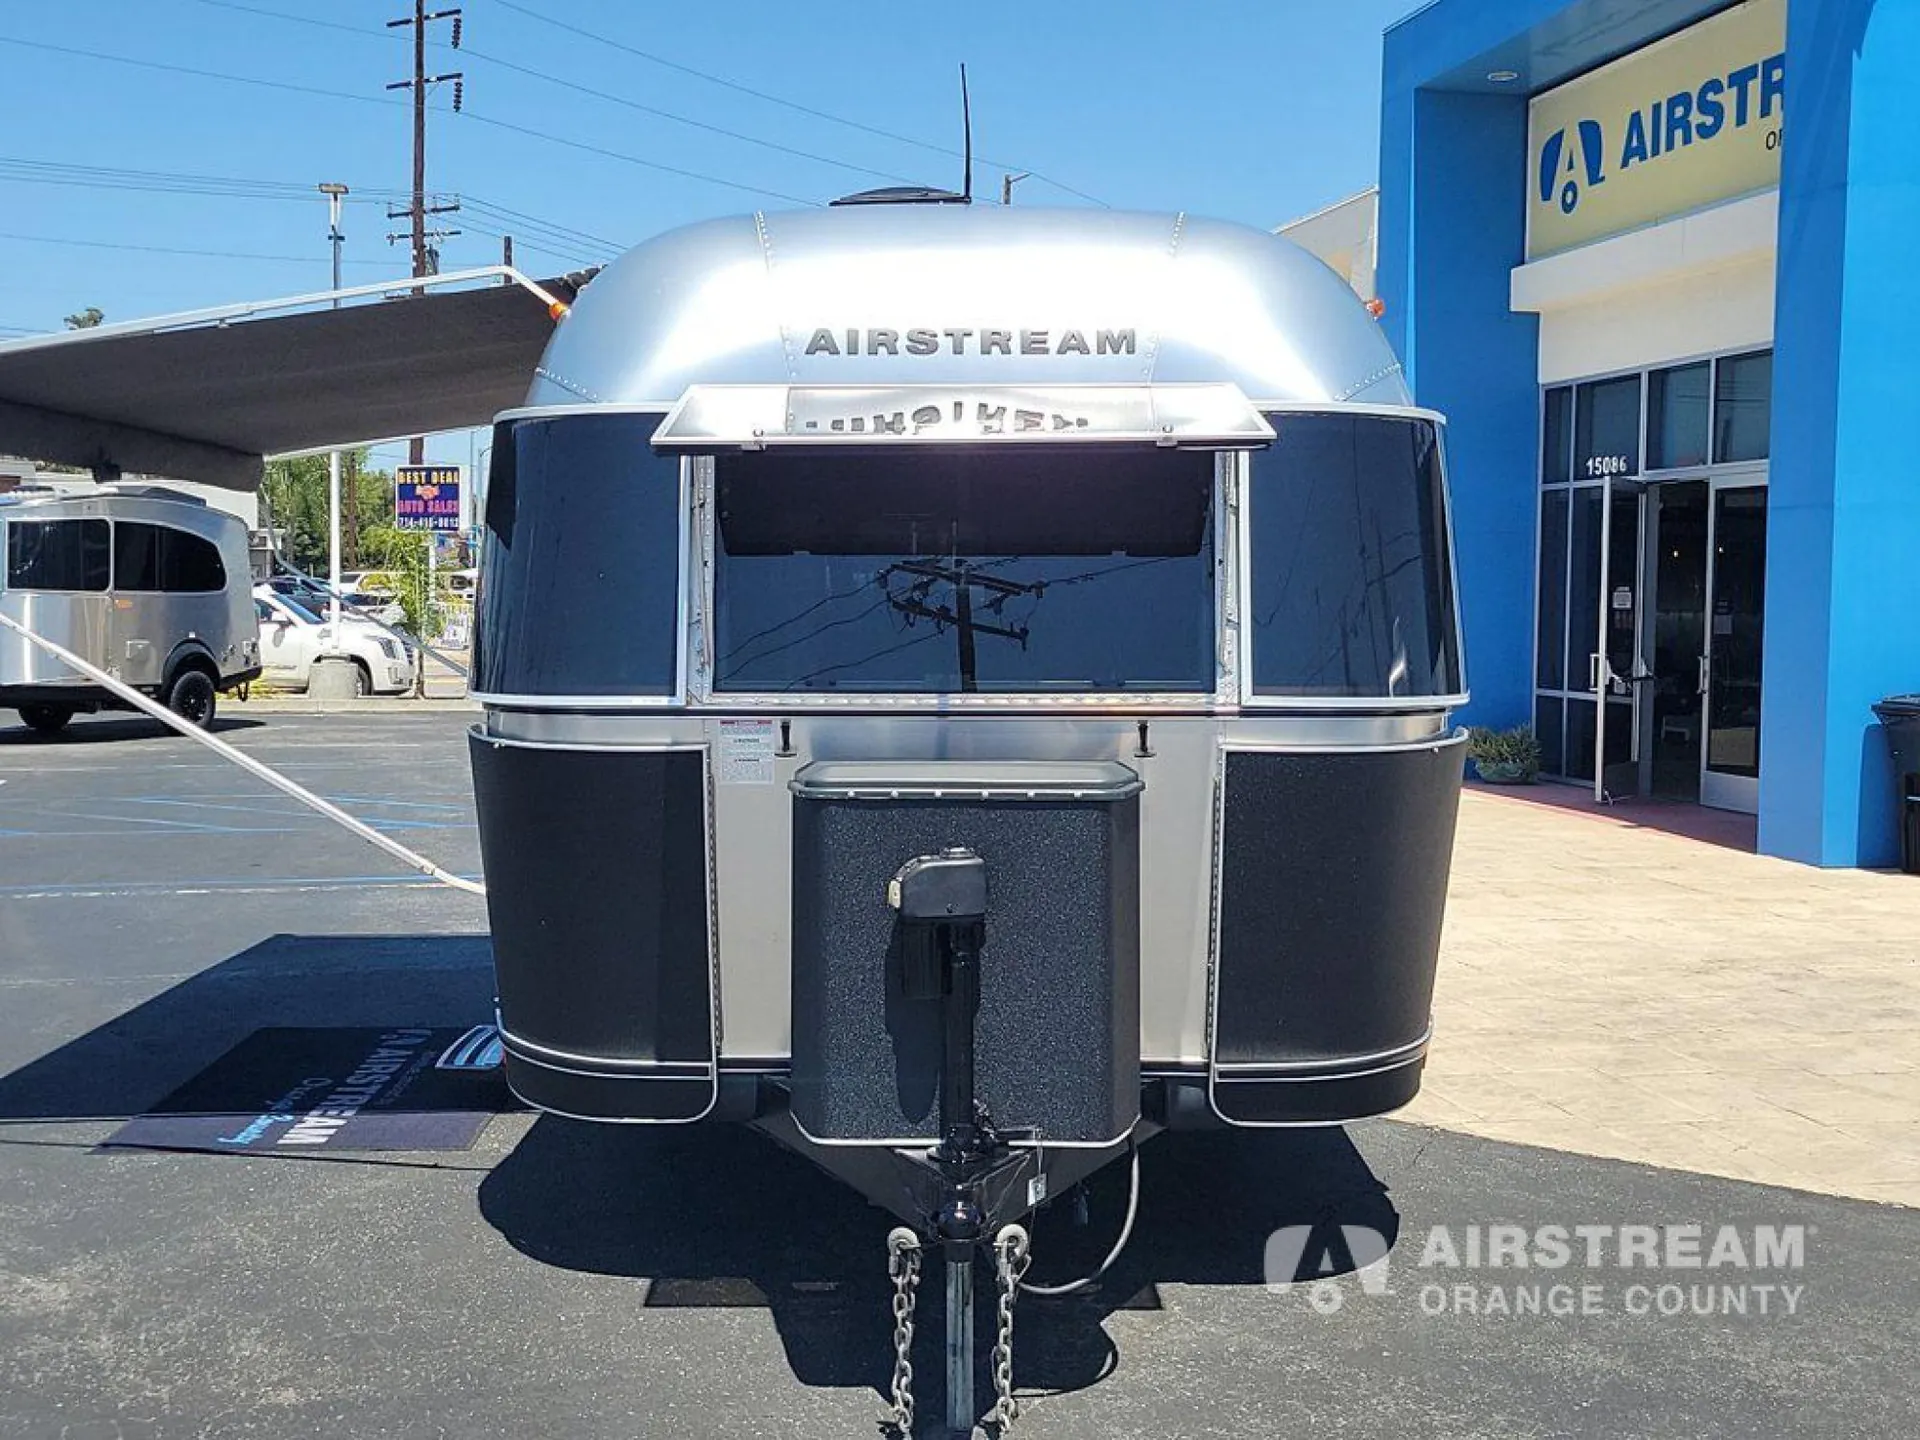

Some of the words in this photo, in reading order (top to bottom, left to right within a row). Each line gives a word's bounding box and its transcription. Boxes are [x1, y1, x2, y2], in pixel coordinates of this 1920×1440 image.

[804, 328, 1137, 356] AIRSTREAM
[1586, 456, 1628, 475] 15086
[398, 471, 426, 484] BEST
[431, 471, 458, 484] DEAL
[398, 500, 424, 513] AUTO
[427, 500, 458, 513] SALES
